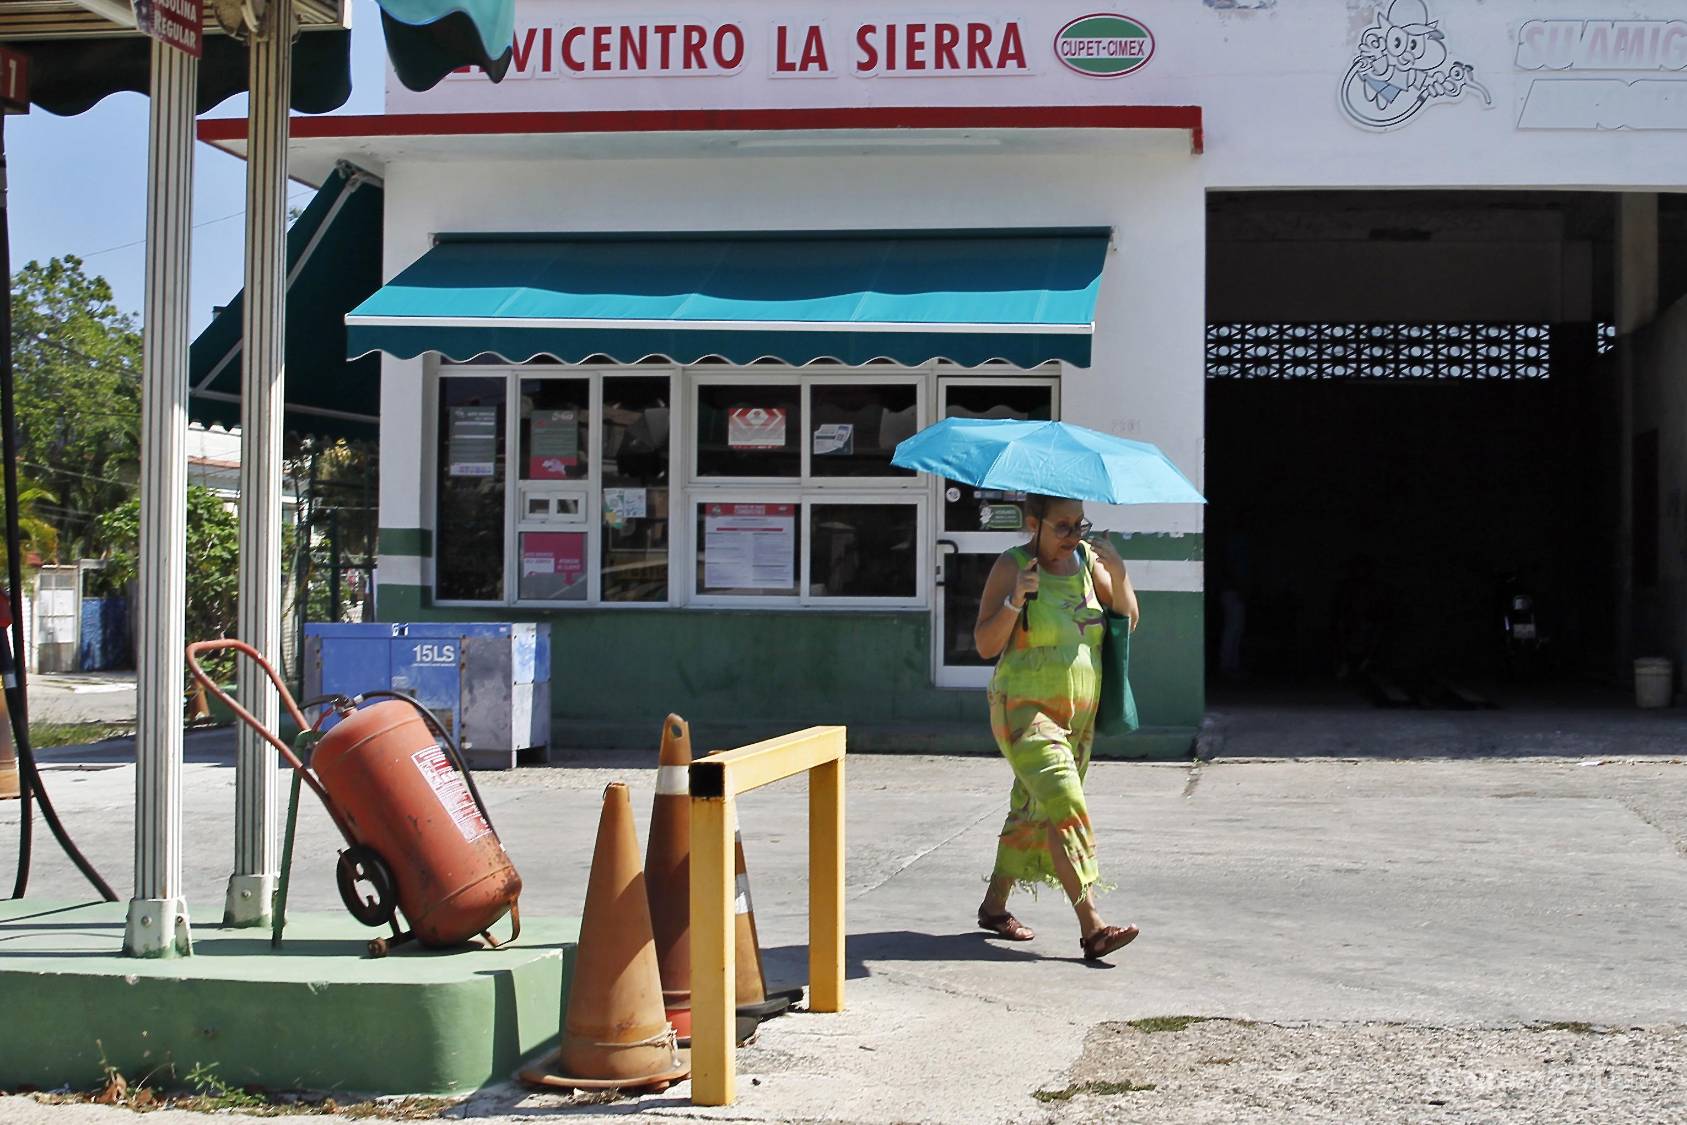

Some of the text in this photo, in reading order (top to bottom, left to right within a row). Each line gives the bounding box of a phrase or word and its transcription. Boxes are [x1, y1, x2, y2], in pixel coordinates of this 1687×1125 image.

[455, 22, 1026, 74] VICENTRO LA SIERRA
[1061, 40, 1145, 57] CUPET-CIMEX
[412, 644, 455, 662] 15LS
